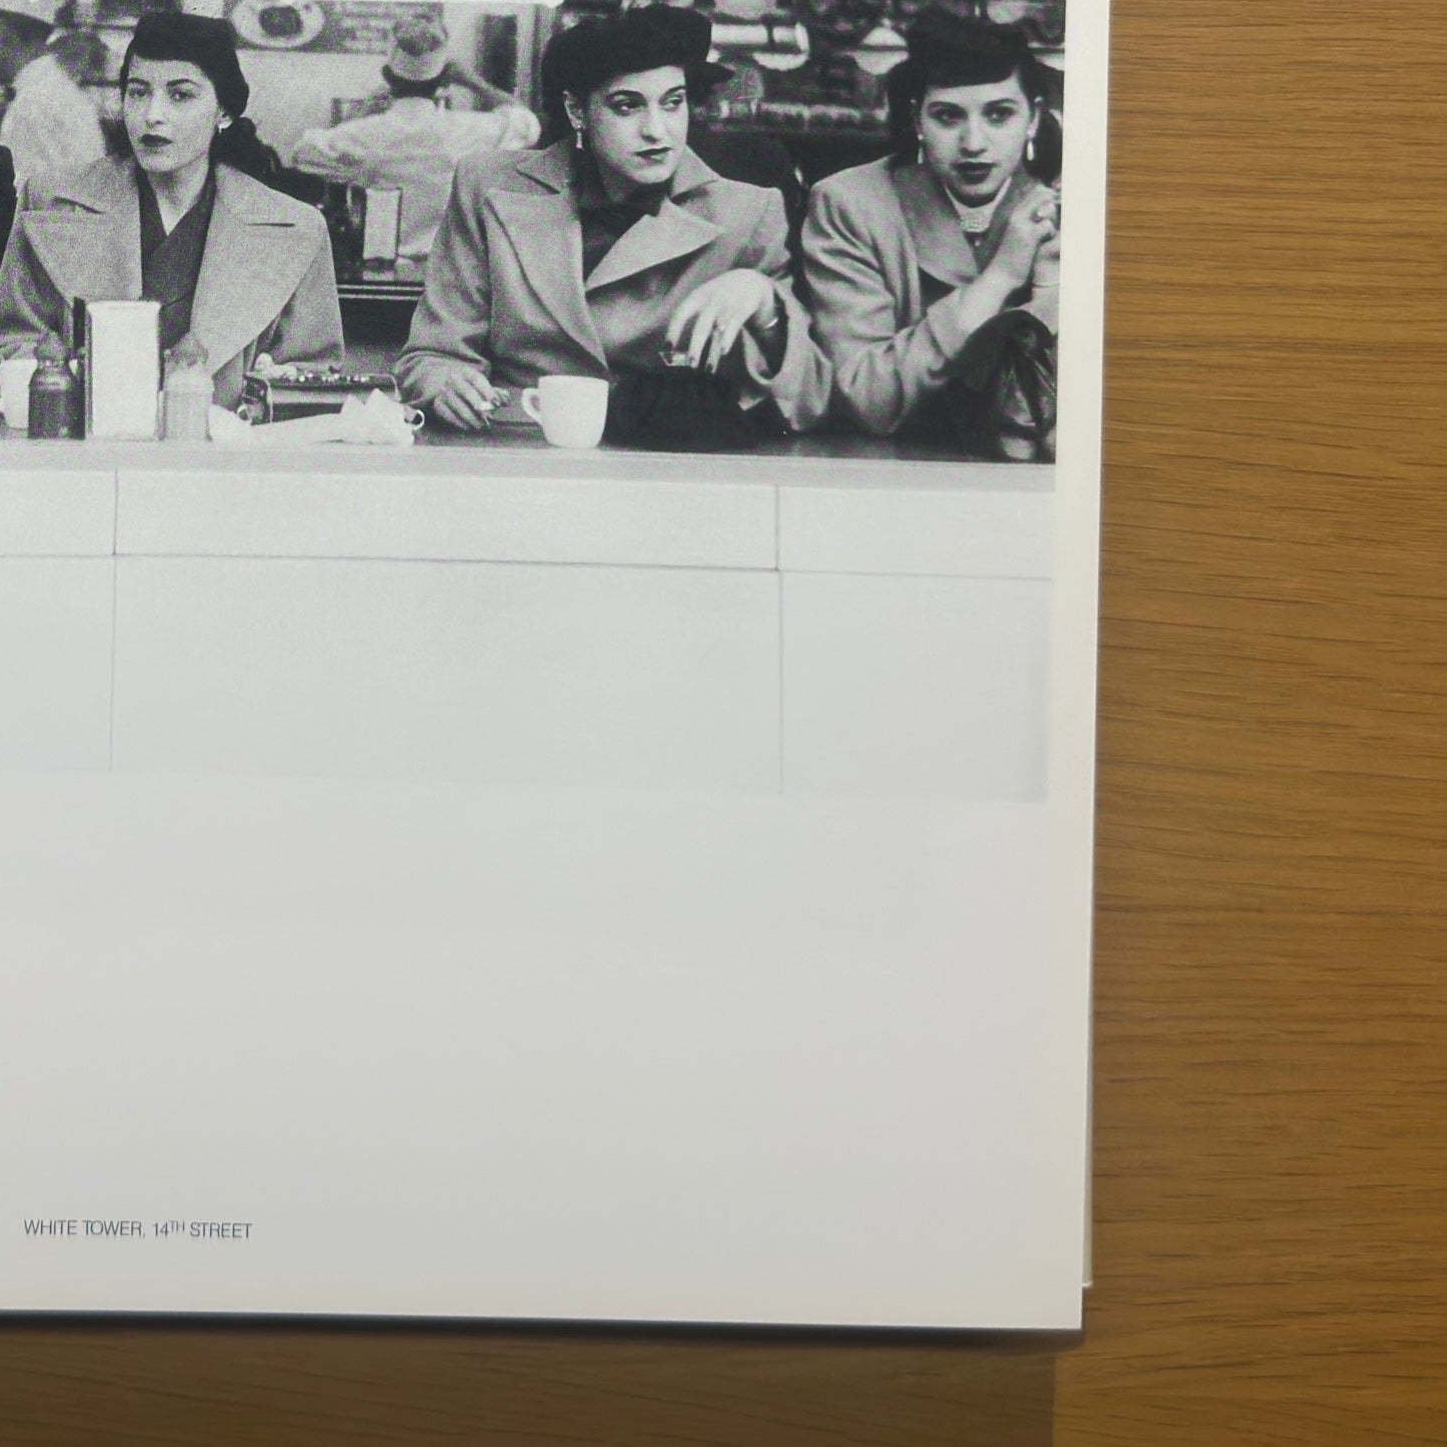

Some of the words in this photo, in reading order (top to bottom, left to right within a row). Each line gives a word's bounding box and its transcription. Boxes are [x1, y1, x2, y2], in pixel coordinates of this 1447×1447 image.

[23, 1219, 78, 1236] WHITE
[82, 1219, 147, 1239] TOWER,
[153, 1220, 185, 1237] 14TH
[189, 1221, 253, 1239] STREET
